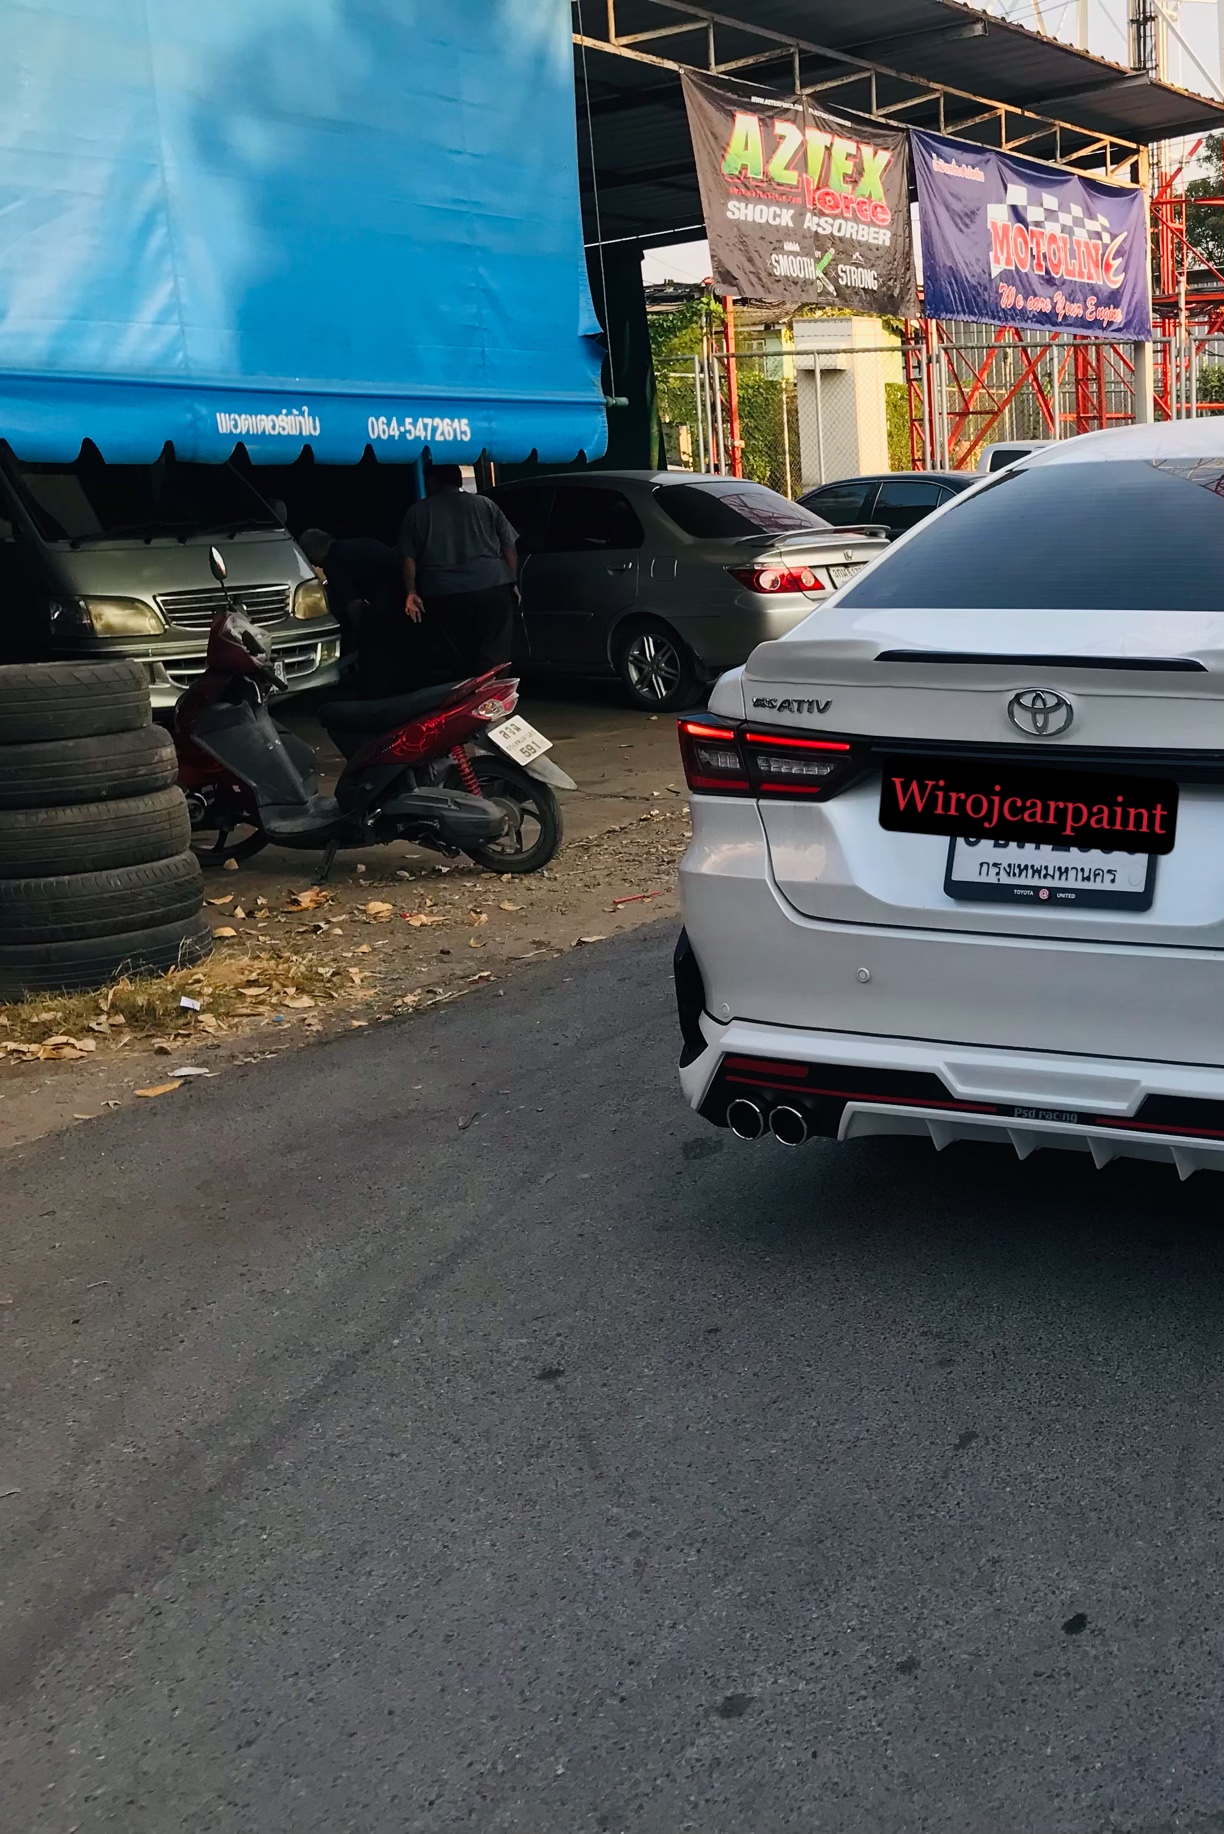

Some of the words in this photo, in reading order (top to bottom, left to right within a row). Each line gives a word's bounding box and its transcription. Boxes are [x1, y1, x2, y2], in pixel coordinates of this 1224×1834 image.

[721, 112, 893, 206] AZTEX
[727, 200, 795, 228] SHOCK
[989, 218, 1127, 289] MOTOLINE
[771, 253, 816, 280] SMOOTH
[837, 264, 878, 291] STRONG
[1027, 295, 1051, 313] care
[367, 416, 471, 441] 064-5472615
[777, 698, 833, 714] ATIV
[519, 741, 541, 758] 591
[978, 860, 1118, 884] กรุงเทพมหานคร
[1014, 1107, 1036, 1119] Psd
